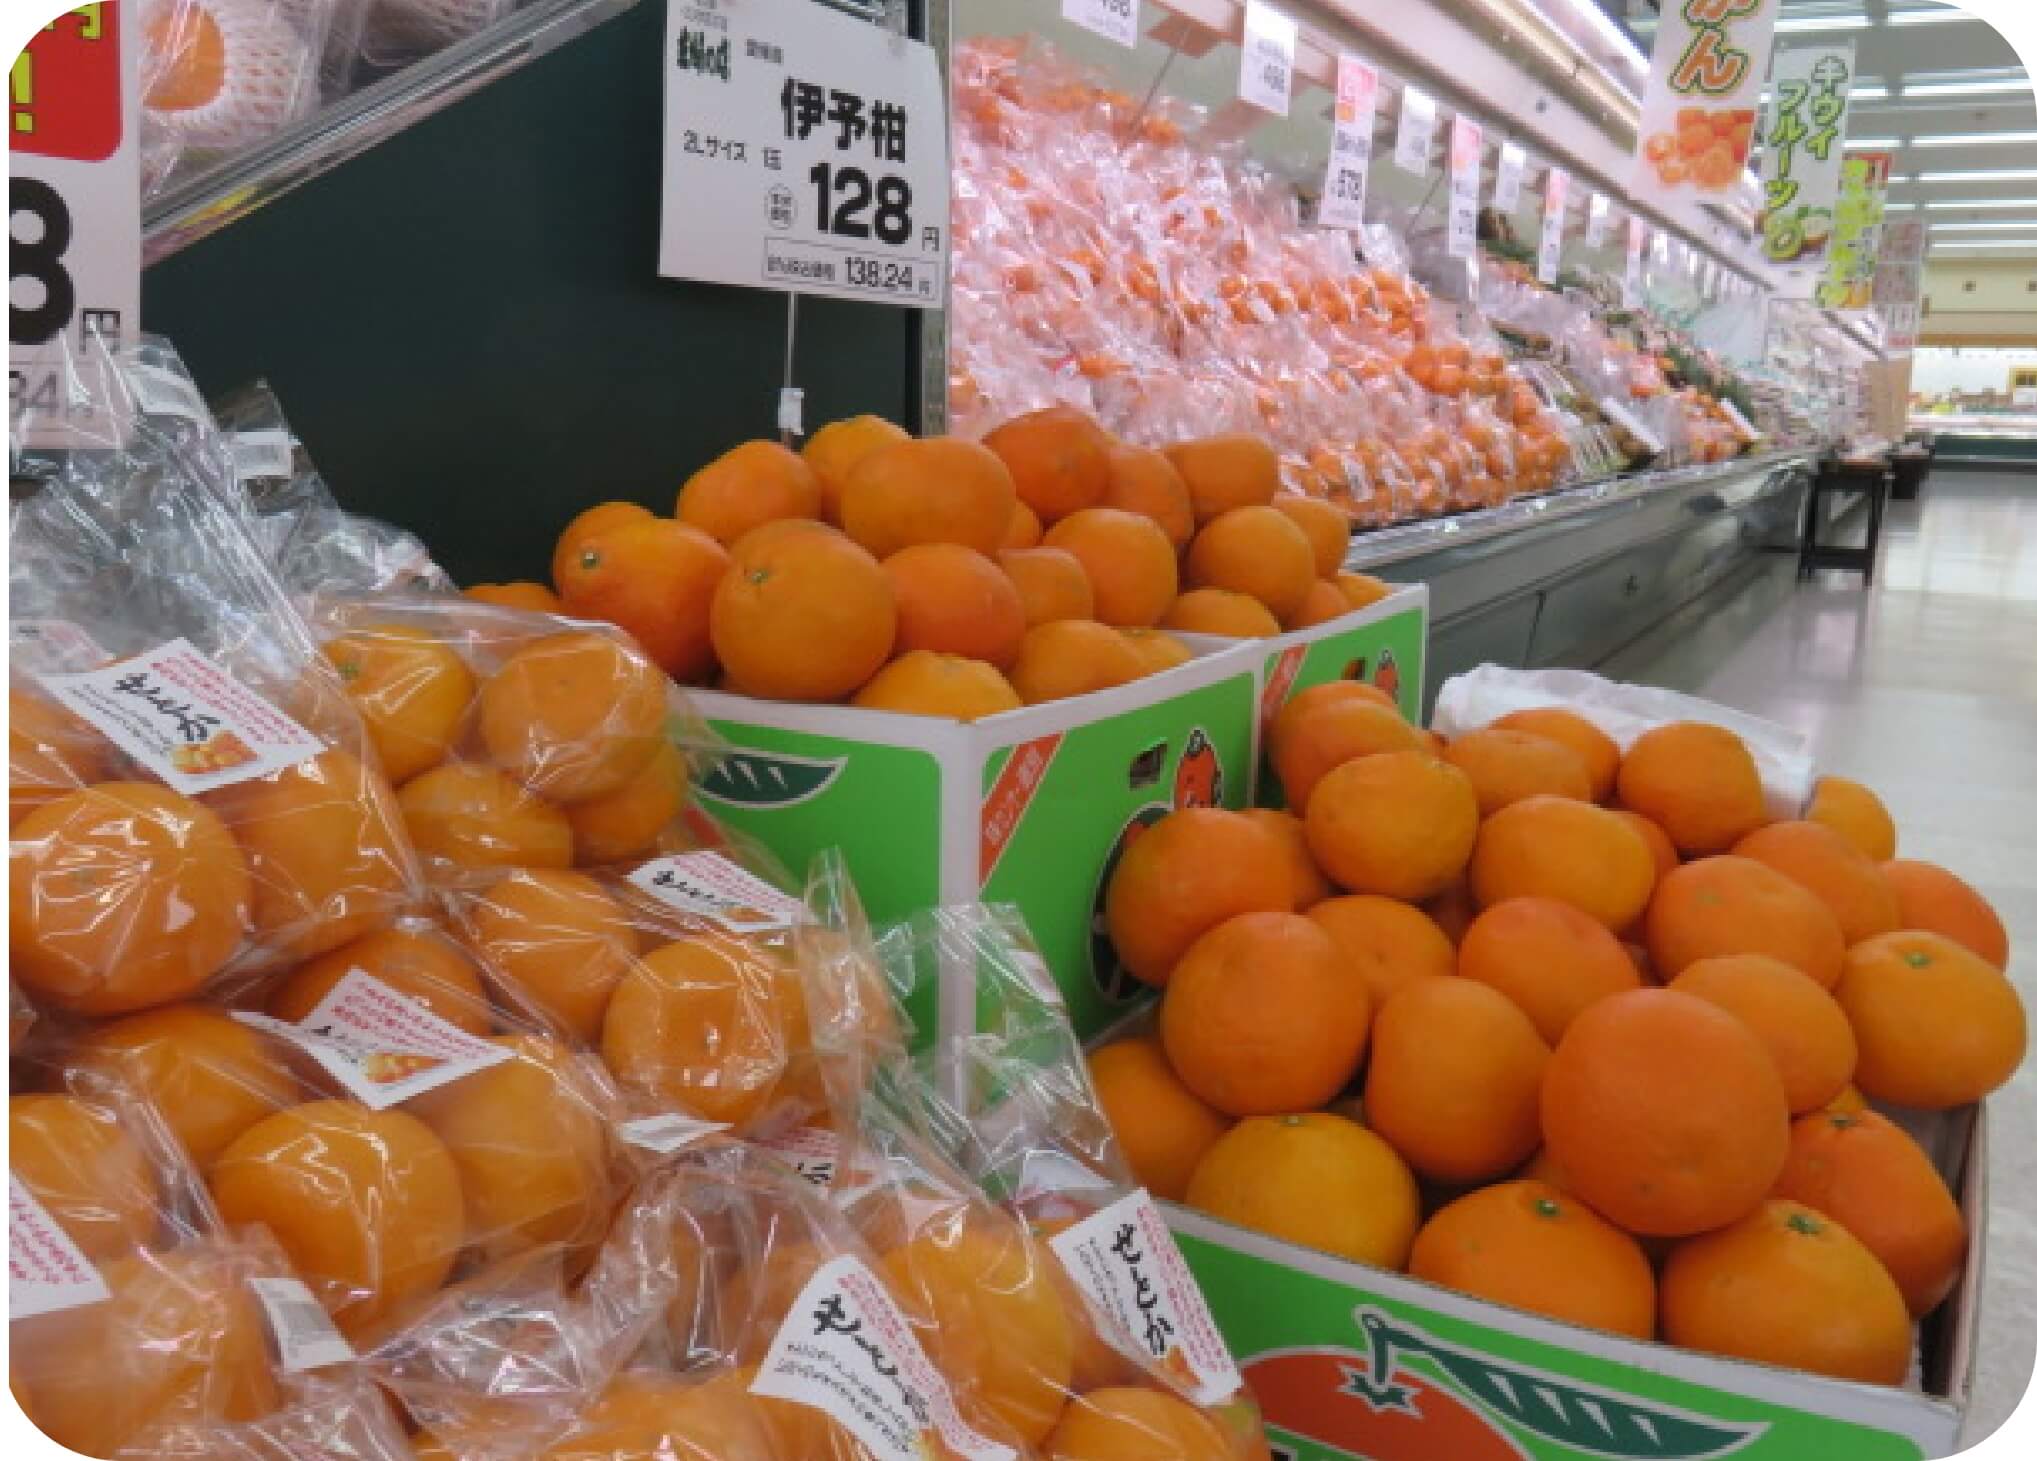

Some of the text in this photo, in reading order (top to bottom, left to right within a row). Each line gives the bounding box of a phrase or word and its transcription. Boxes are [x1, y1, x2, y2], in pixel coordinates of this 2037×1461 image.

[781, 75, 906, 163] 伊予柑
[810, 162, 912, 245] 128
[845, 256, 913, 288] 138.24
[1110, 1223, 1174, 1356] せとか
